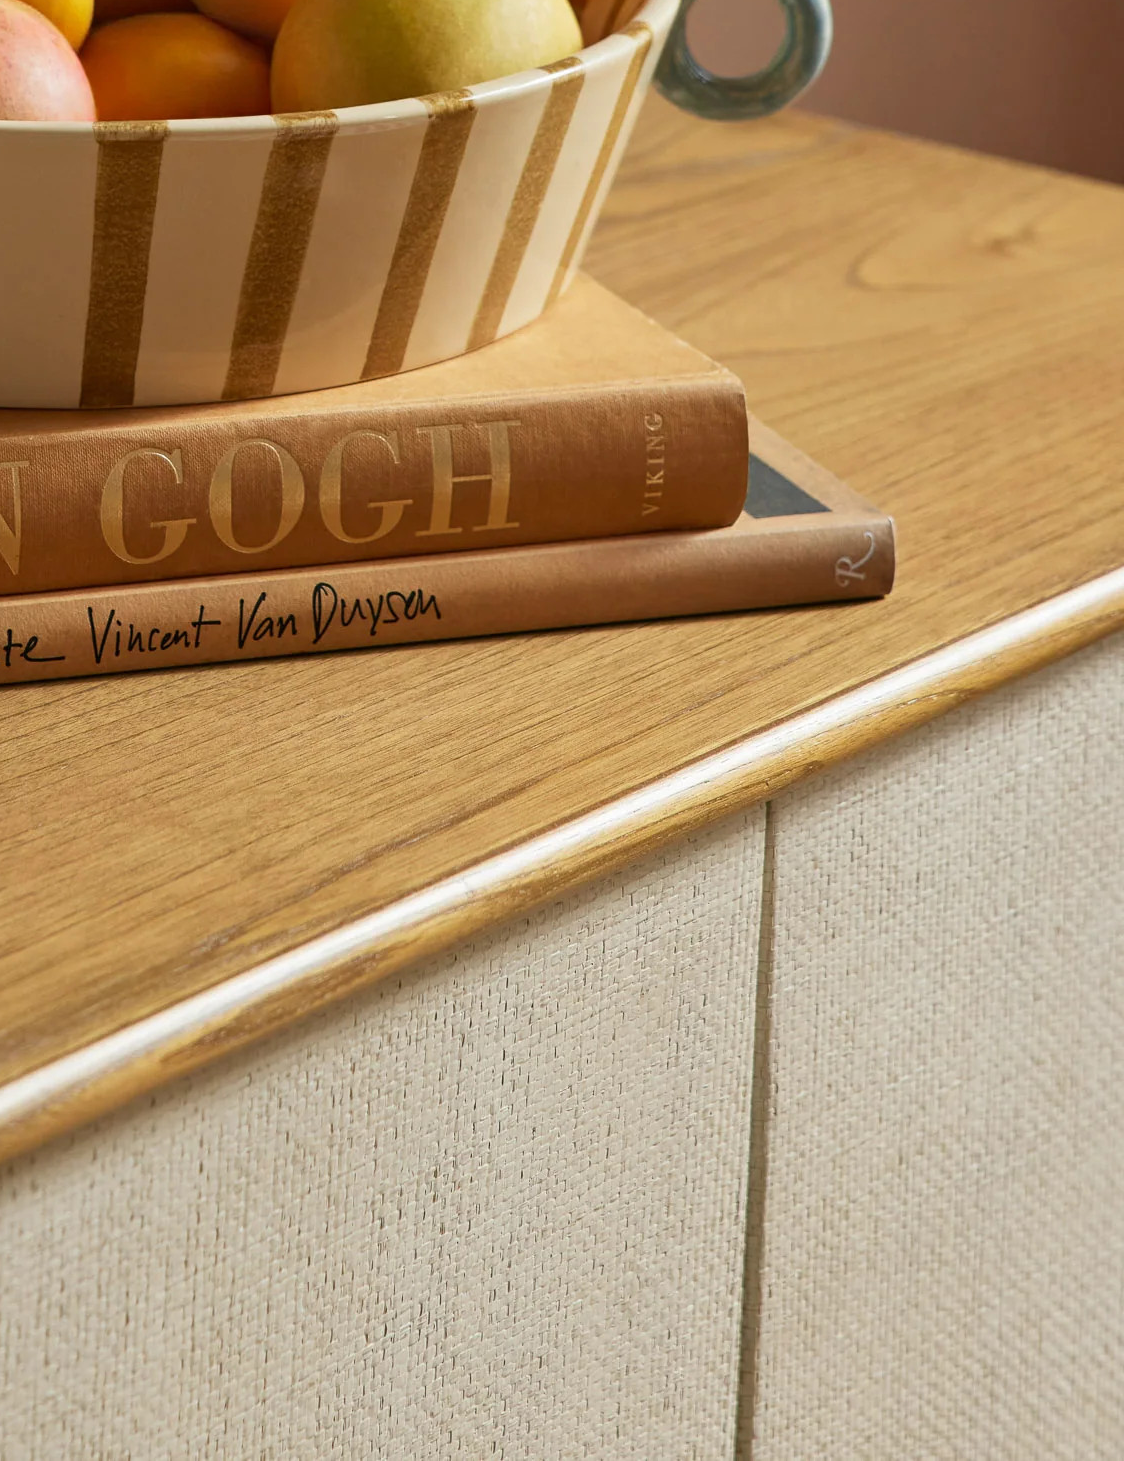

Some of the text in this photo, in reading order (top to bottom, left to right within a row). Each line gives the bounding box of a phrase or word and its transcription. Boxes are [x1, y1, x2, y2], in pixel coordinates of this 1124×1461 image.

[99, 419, 522, 565] GOGH
[642, 413, 665, 516] VIKING
[88, 604, 221, 664] Vincent
[238, 591, 298, 649] Van
[312, 582, 442, 644] Duysen
